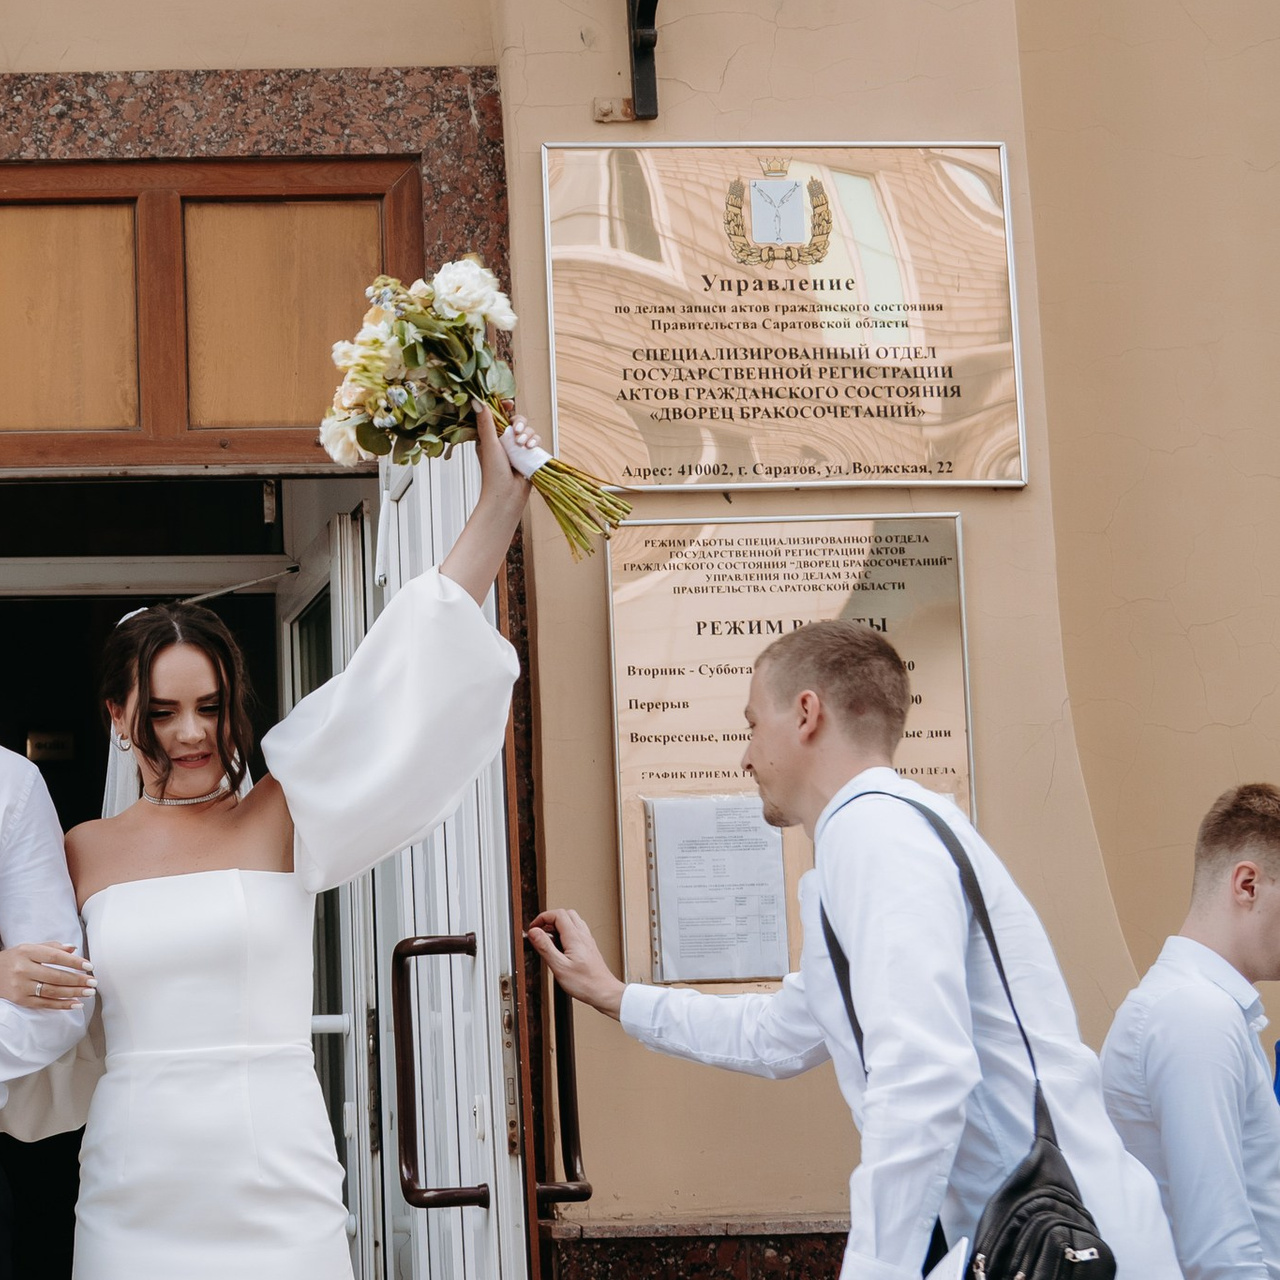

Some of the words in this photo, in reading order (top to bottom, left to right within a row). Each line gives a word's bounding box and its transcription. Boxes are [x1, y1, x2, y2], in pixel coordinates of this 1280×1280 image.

[702, 274, 855, 296] Управление
[635, 305, 675, 314] делам
[680, 305, 726, 313] записи
[731, 304, 769, 313] актов
[775, 304, 869, 315] гражданского
[874, 303, 943, 311] состояния
[651, 320, 757, 332] Правительства
[762, 318, 850, 332] Саратовской
[856, 318, 908, 328] области
[633, 344, 869, 362] СПЕЦИАЛИЗИРОВАННЫЙ
[876, 347, 936, 362] ОТДЕЛ
[623, 364, 812, 381] ГОСУДАРСТВЕННОЙ
[818, 366, 952, 380] РЕГИСТРАЦИИ
[616, 388, 678, 400] АКТОВ
[686, 386, 838, 401] ГРАЖДАНСКОГО
[845, 385, 961, 398] СОСТОЯНИЯ
[650, 407, 734, 421] «ДВОРЕЦ
[741, 403, 925, 419] БРАКОСОЧЕТАНИЙ»
[622, 466, 672, 478] Адрес:
[678, 464, 733, 476] 410002,
[739, 467, 747, 475] г.
[753, 463, 820, 477] Саратов,
[853, 462, 932, 474] Волжская,
[937, 462, 952, 473] 22
[645, 539, 686, 547] РЕЖИМ
[690, 539, 734, 547] РАБОТЫ
[738, 535, 882, 546] СПЕЦИАЛИЗИРОВАННОГО
[885, 535, 929, 544] ОТДЕЛА
[670, 548, 781, 559] ГОСУДАРСТВЕННОЙ
[785, 548, 864, 557] РЕГИСТРАЦИИ
[870, 547, 905, 555] АКТОВ
[624, 563, 714, 571] ГРАЖДАНСКОГО
[718, 561, 786, 570] СОСТОЯНИЯ
[706, 573, 779, 582] УПРАВЛЕНИЯ
[802, 572, 841, 581] ДЕЛАМ
[845, 571, 871, 579] ЗАГС
[673, 585, 765, 594] ПРАВИТЕЛЬСТВА
[770, 582, 849, 592] САРАТОВСКОЙ
[853, 582, 905, 590] ОБЛАСТИ
[696, 620, 783, 635] РЕЖИМ
[628, 665, 685, 678] Вторник
[699, 664, 752, 677] Суббота
[628, 699, 689, 712] Перерыв
[630, 732, 718, 744] Воскресенье,
[927, 730, 951, 738] дни
